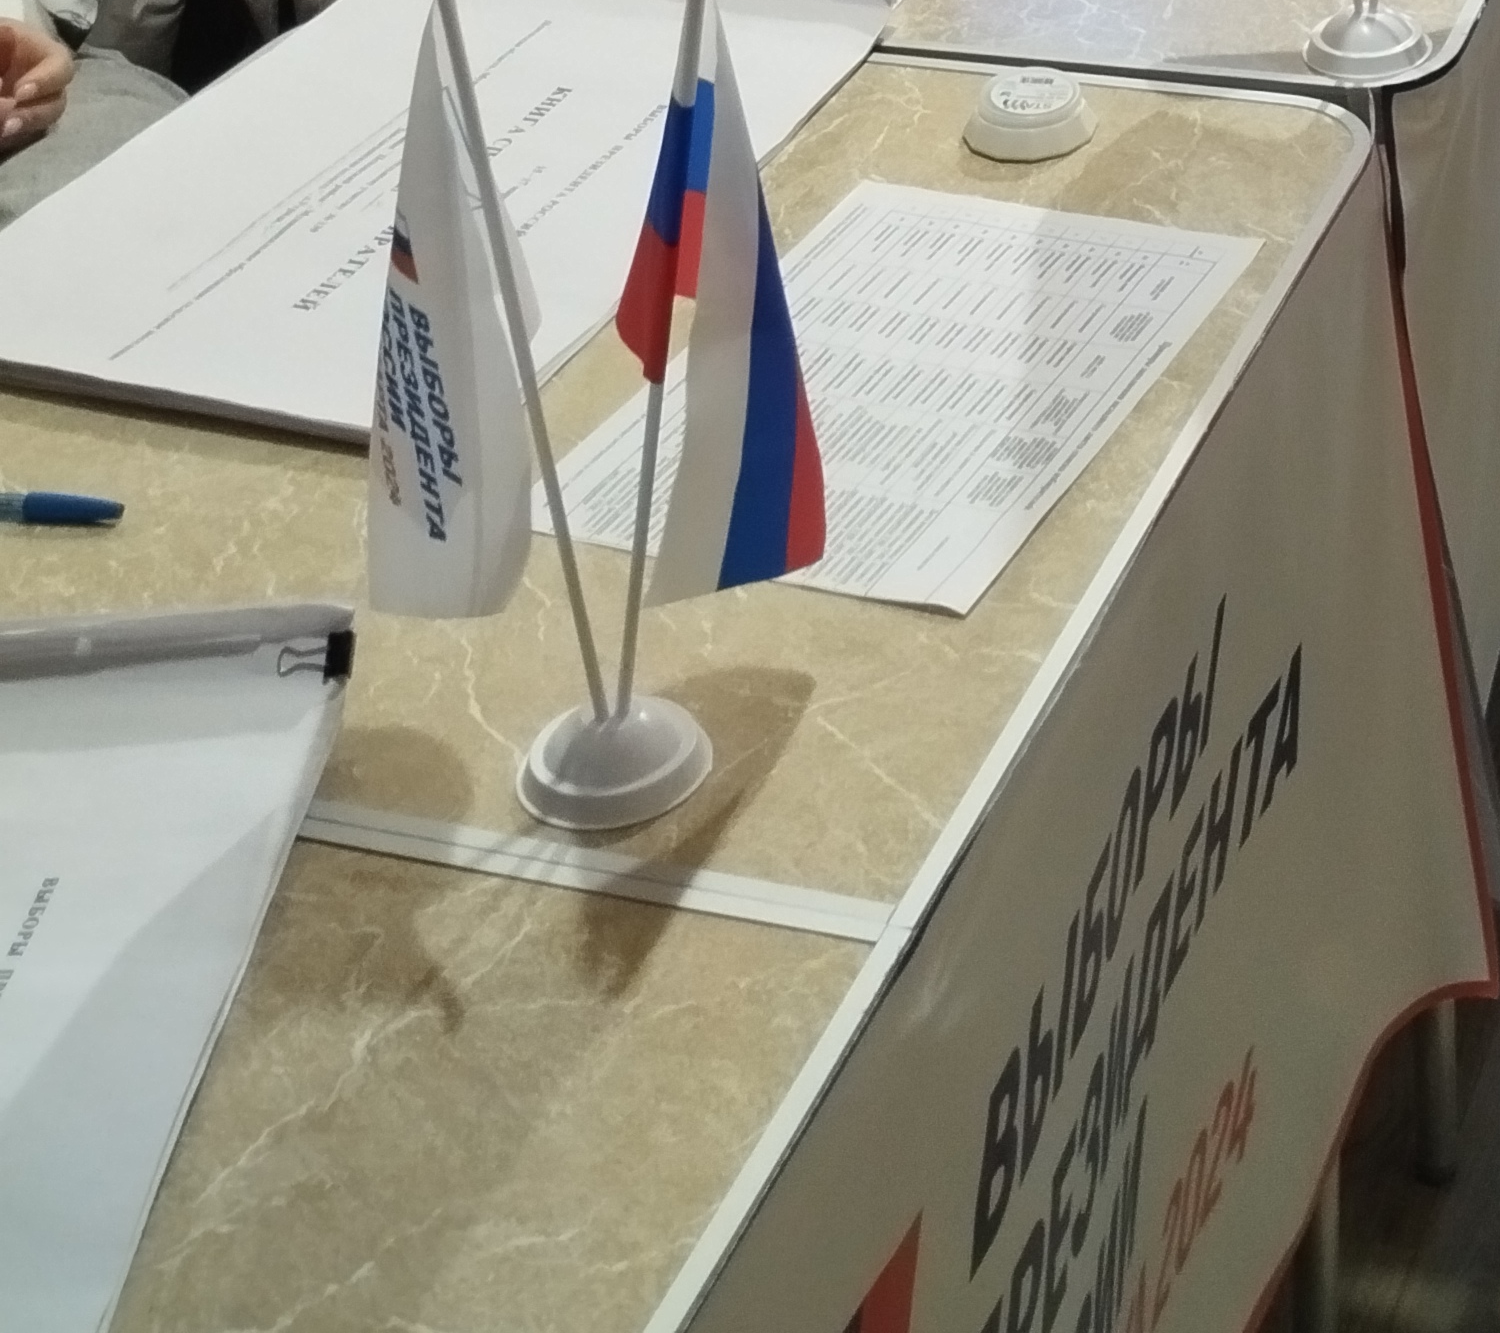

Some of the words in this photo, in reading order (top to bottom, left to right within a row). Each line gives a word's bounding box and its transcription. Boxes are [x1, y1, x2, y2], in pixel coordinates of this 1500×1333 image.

[507, 85, 573, 135] КНИГА
[292, 225, 395, 312] РАТЕЛЕЙ
[388, 287, 447, 543] ПРЕЗИДЕНТА
[408, 303, 463, 487] ВЫБОРЫ
[7, 877, 60, 958] ВЫБОРЫ
[970, 593, 1227, 1282] ВЫБОРЫ
